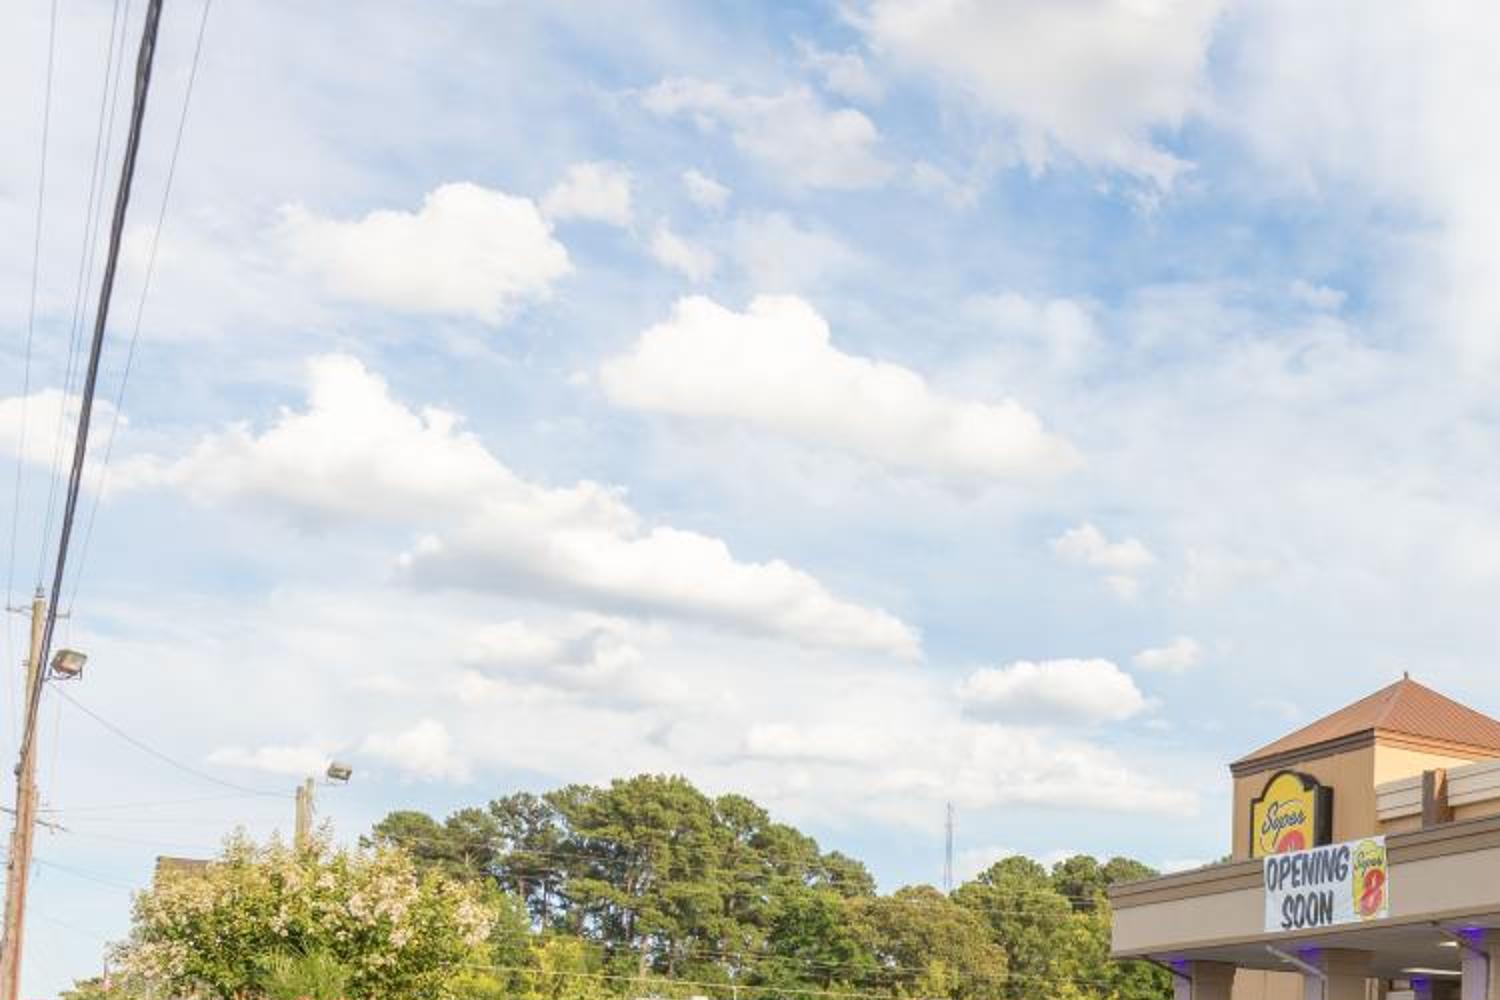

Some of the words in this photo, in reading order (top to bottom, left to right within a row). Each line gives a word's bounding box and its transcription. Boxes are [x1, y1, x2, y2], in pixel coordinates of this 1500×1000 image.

[1266, 846, 1350, 892] OPENING
[1359, 868, 1385, 915] 8
[1281, 890, 1335, 929] SOON
